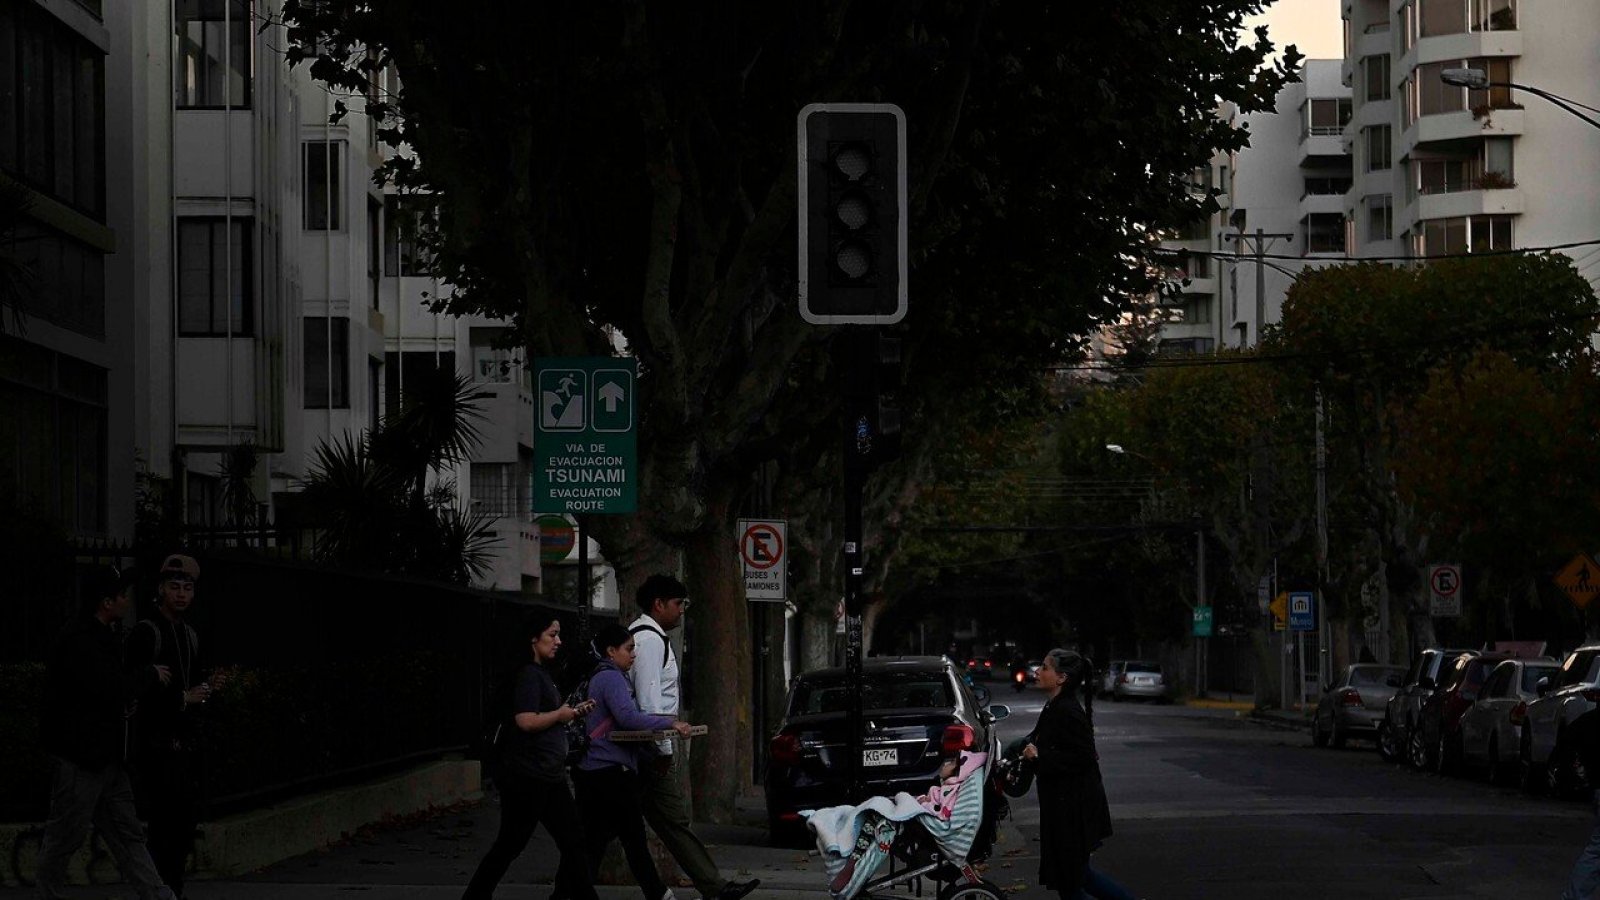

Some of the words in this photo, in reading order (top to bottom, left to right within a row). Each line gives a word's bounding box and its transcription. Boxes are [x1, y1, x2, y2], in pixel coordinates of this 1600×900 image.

[565, 443, 584, 453] VIA
[590, 443, 606, 453] DE
[549, 456, 623, 466] EVACUACION
[545, 468, 626, 483] TSUNAMI
[549, 487, 621, 498] EVACUATION
[565, 501, 605, 510] ROUTE
[773, 571, 778, 579] Y
[746, 582, 780, 591] AMIONES
